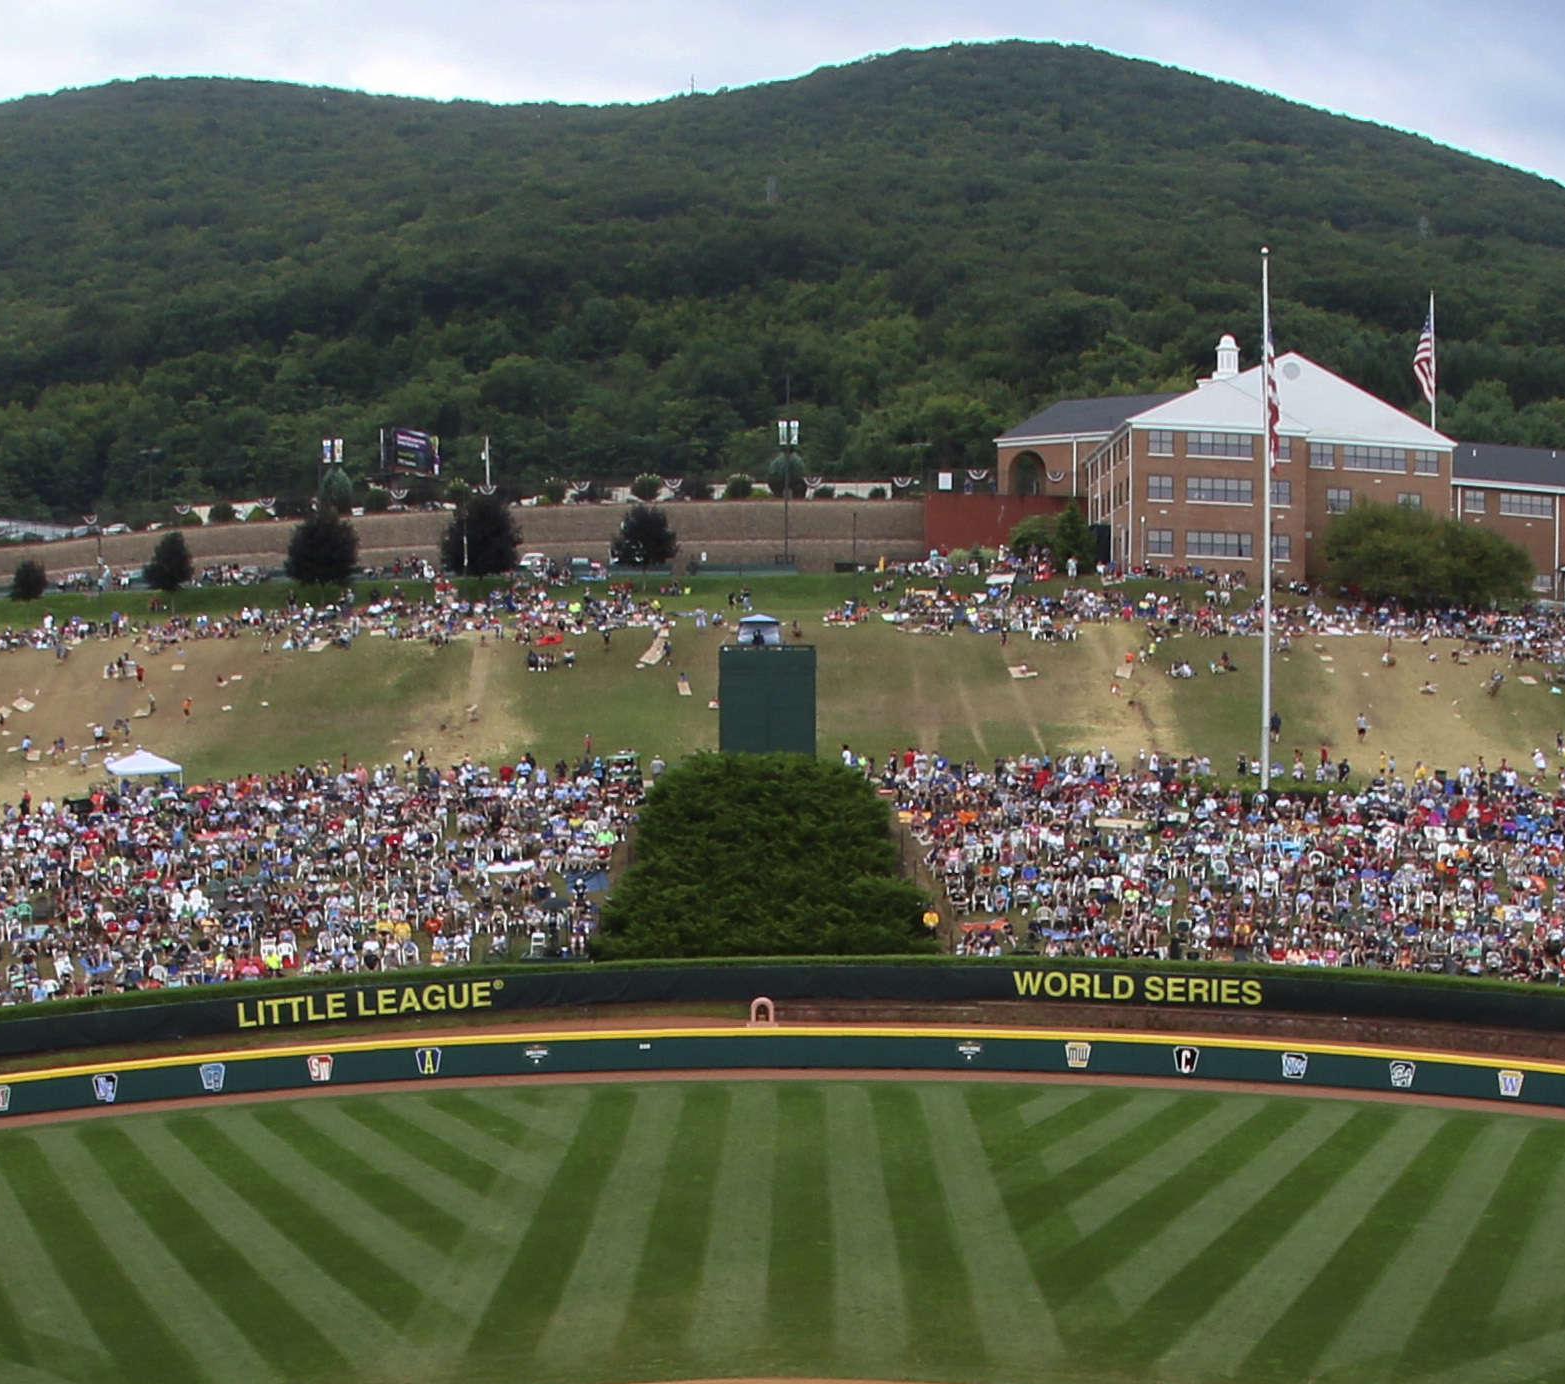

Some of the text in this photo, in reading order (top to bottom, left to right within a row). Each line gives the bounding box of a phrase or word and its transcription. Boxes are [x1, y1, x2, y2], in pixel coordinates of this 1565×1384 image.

[1012, 970, 1263, 1006] WORLD SERIES
[237, 991, 347, 1029] LITTLE
[311, 1058, 332, 1081] SW
[1501, 1076, 1519, 1093] W
